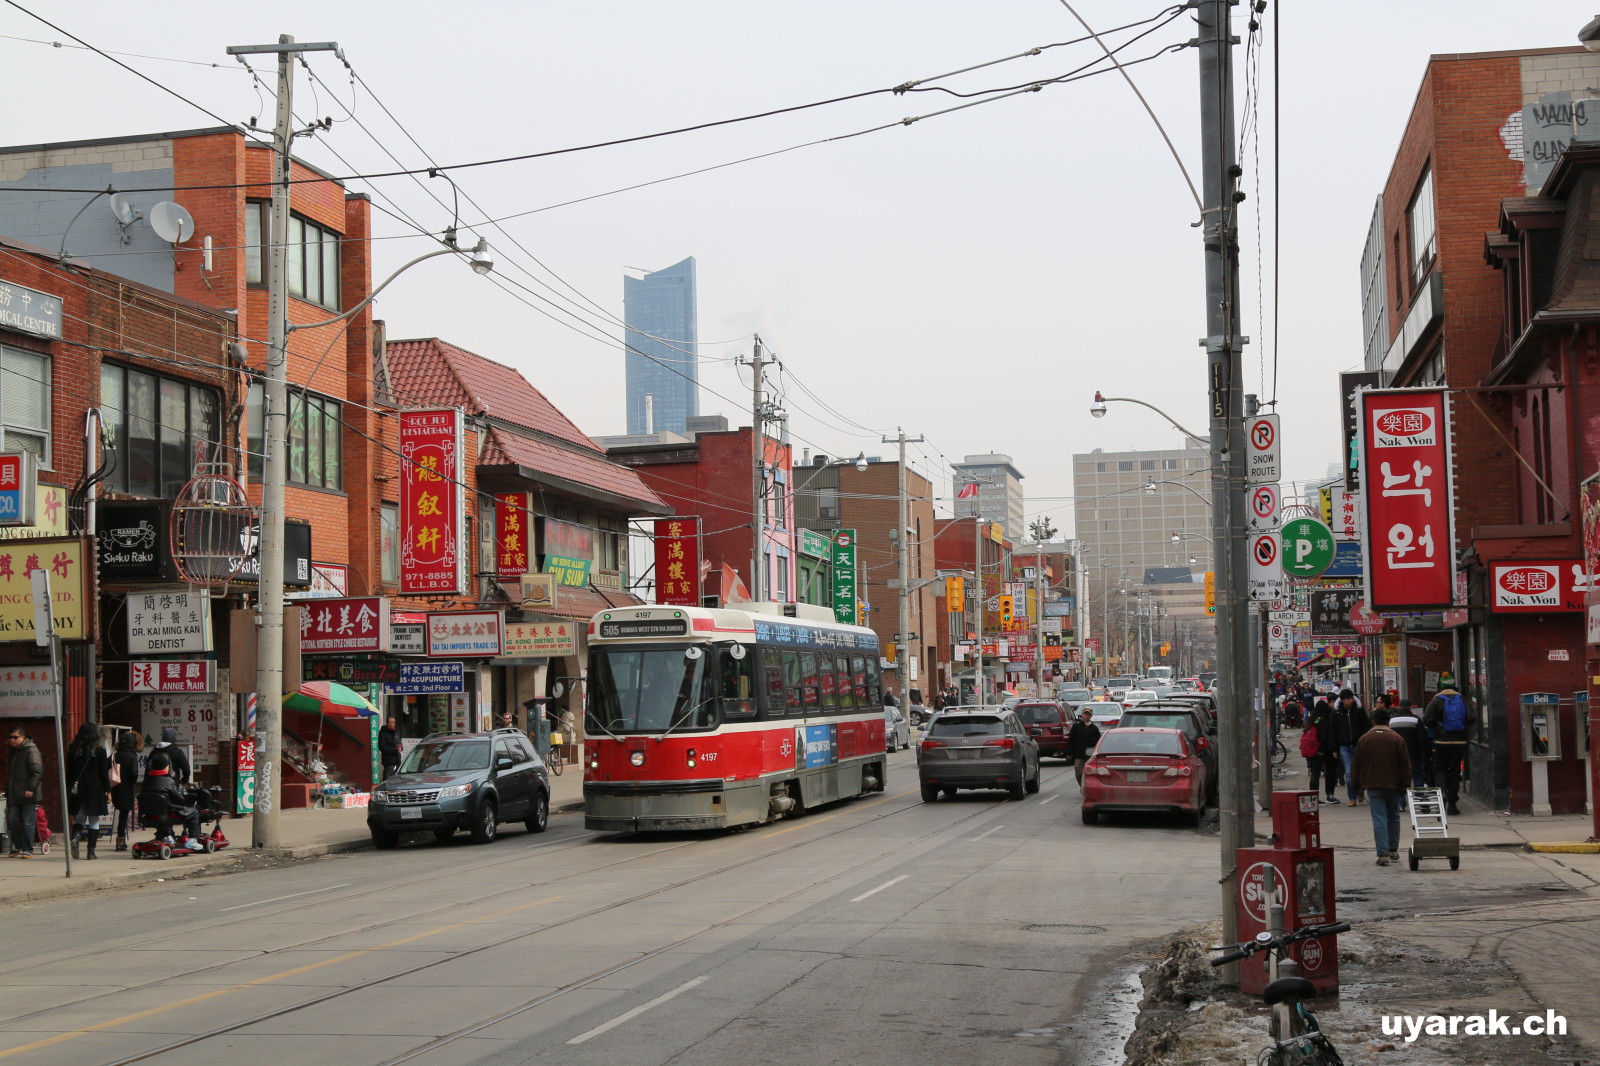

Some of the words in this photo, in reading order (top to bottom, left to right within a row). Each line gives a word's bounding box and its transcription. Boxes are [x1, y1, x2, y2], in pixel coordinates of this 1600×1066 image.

[24, 315, 57, 335] CENTRE
[402, 426, 453, 437] RESTAURANT
[1378, 437, 1402, 447] Nak
[1406, 436, 1434, 446] Won
[1253, 454, 1274, 465] SNOW
[1251, 466, 1276, 477] ROUTE
[117, 528, 140, 536] RAMEN
[104, 552, 130, 564] Shoku
[131, 551, 154, 563] Raku
[405, 572, 454, 581] 971-8885
[564, 569, 585, 587] SUM
[1500, 596, 1525, 605] Nak
[1530, 595, 1557, 605] Won
[1273, 612, 1294, 620] LARCH
[132, 628, 146, 637] DR.
[147, 628, 161, 637] KAI
[162, 626, 183, 637] MING
[184, 625, 200, 636] KAN
[603, 625, 619, 636] 505
[148, 638, 186, 649] DENTIST
[333, 638, 344, 648] STYLE
[353, 670, 377, 680] BEER
[162, 681, 185, 690] ANNIE
[186, 679, 205, 690] HAIR
[1533, 694, 1549, 703] Bell
[188, 709, 196, 722] 8
[200, 708, 213, 722] 10
[191, 725, 198, 733] 13
[700, 752, 718, 762] 4197
[1301, 917, 1318, 925] TORONTO
[1317, 916, 1326, 924] SUN
[1303, 949, 1320, 960] SUN
